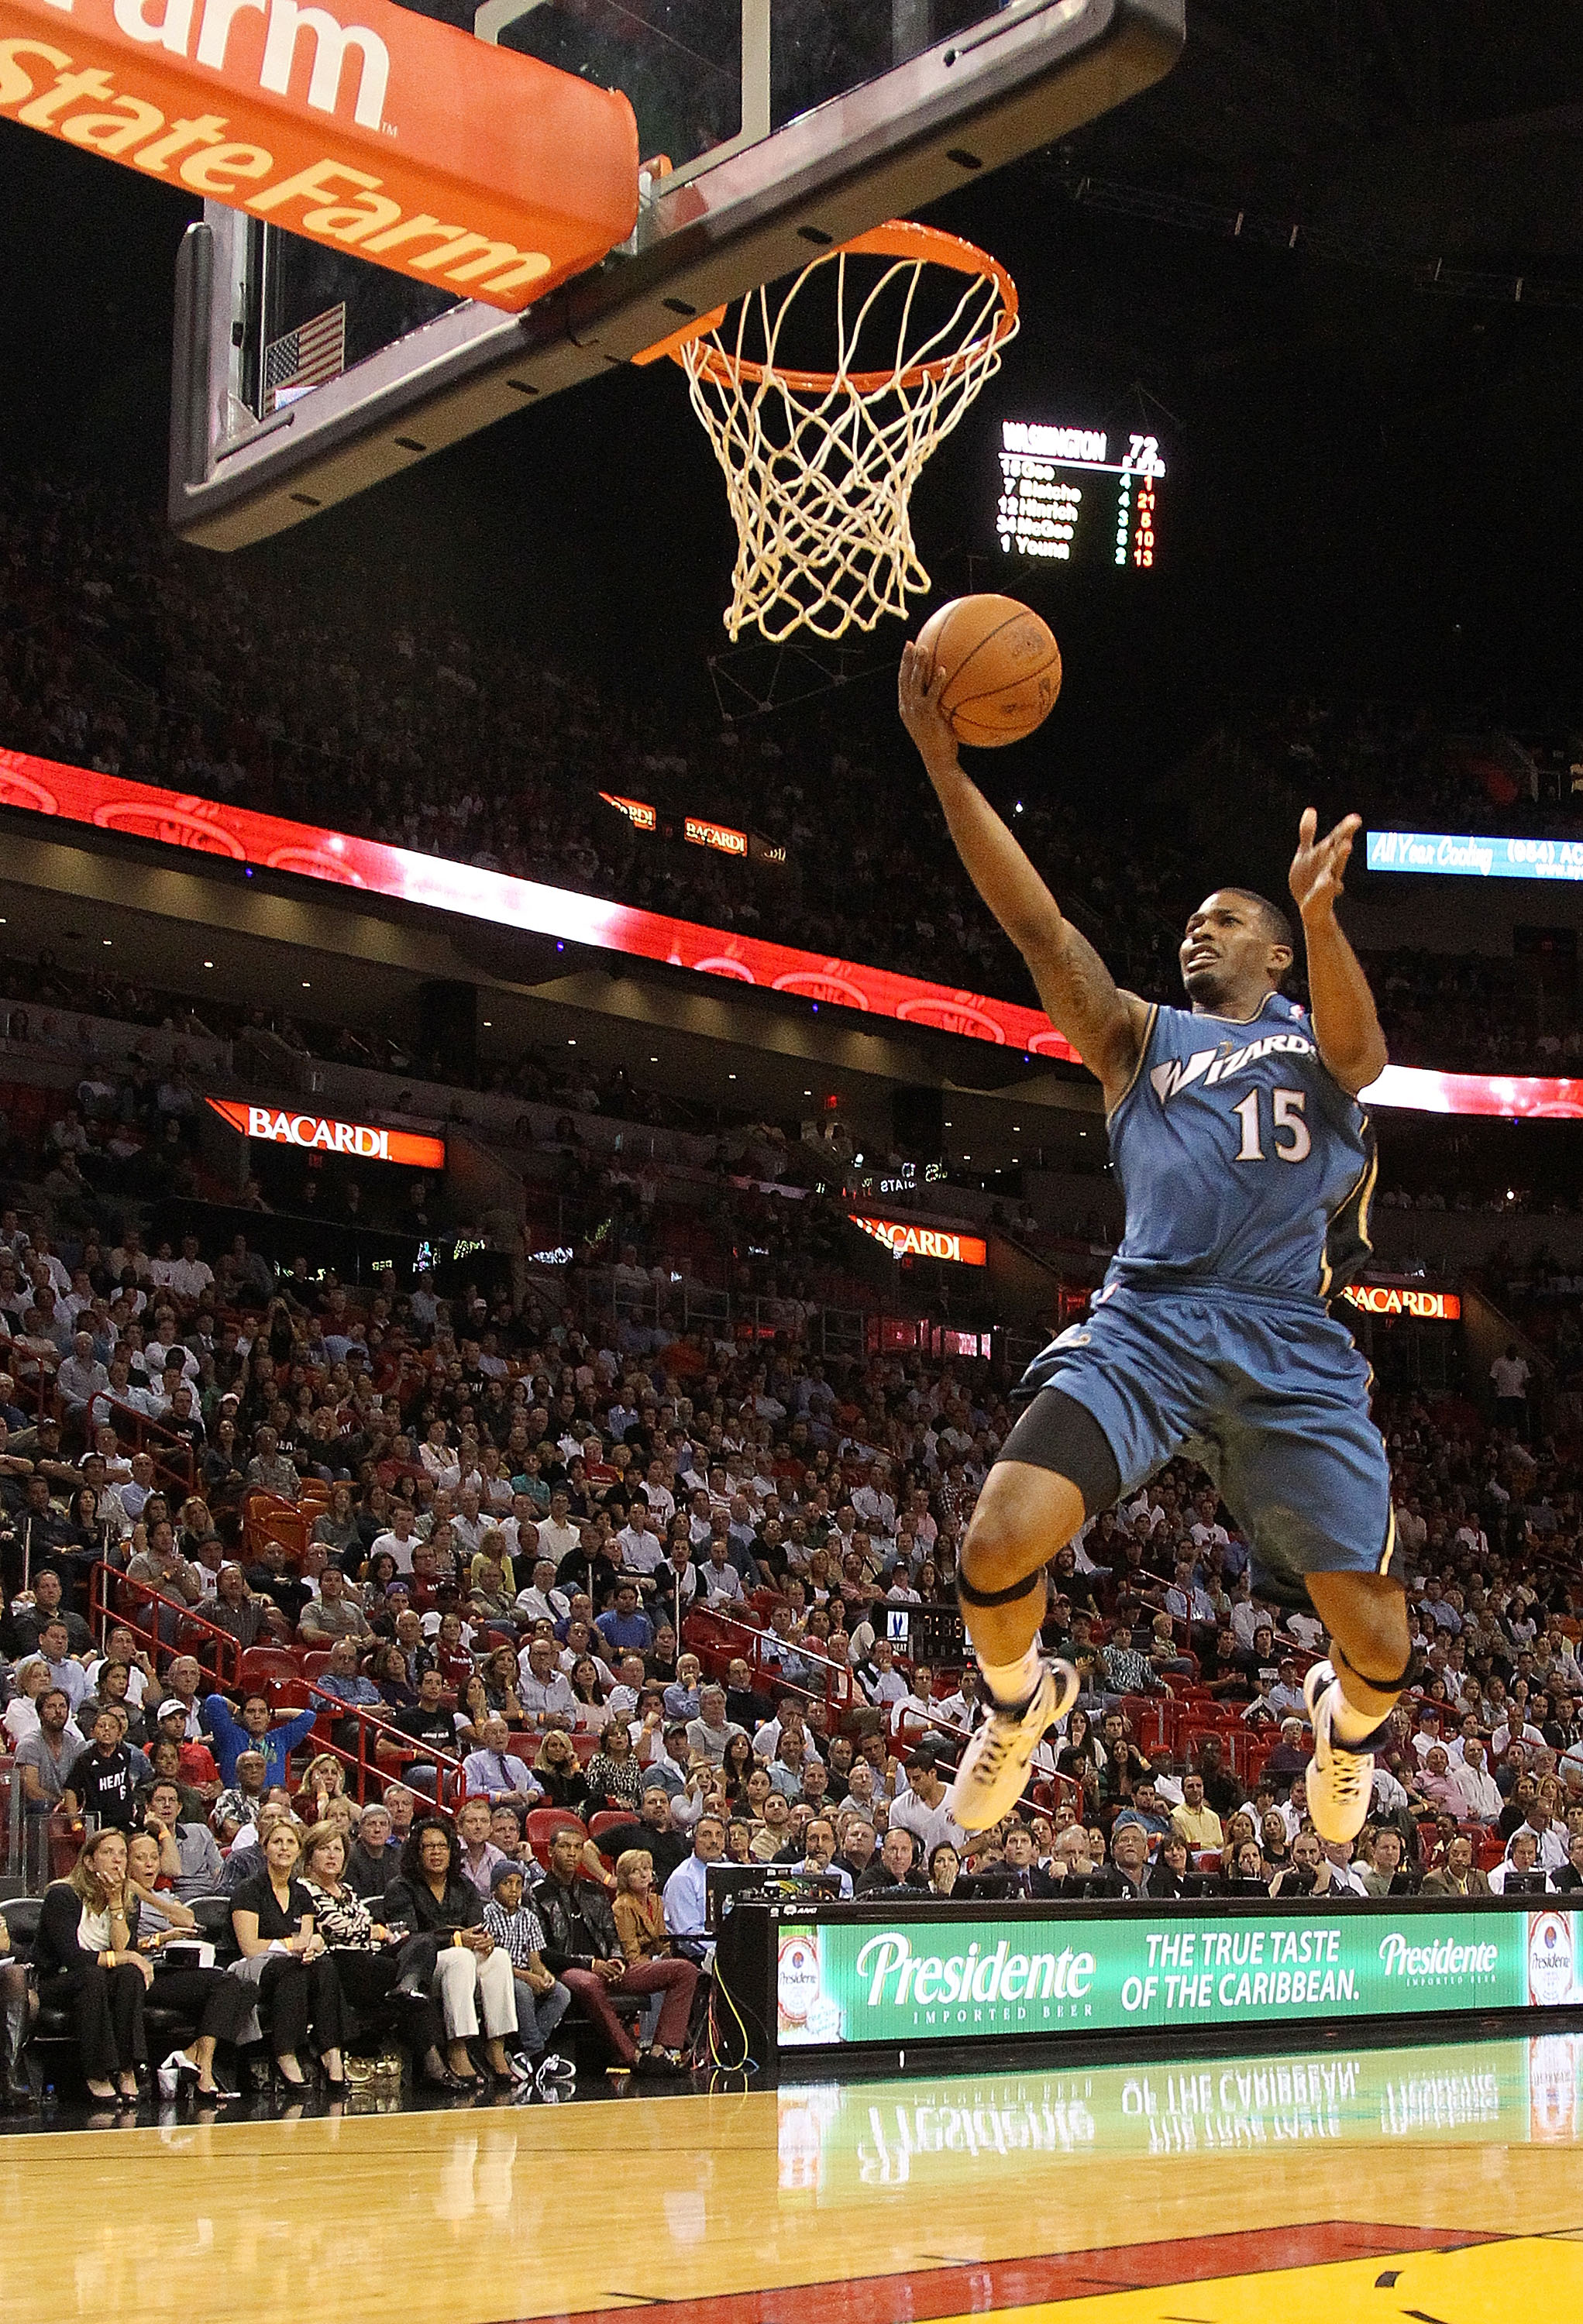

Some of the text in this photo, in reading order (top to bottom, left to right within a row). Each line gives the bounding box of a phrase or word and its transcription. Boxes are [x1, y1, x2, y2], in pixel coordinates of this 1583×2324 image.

[43, 0, 390, 132] arm
[0, 37, 552, 293] State Farm
[1129, 434, 1159, 459] 72
[1003, 477, 1016, 495] 7
[1118, 491, 1130, 508] 4
[1137, 490, 1155, 511] 21
[1120, 473, 1132, 490] 4
[1144, 475, 1152, 491] 1
[1118, 509, 1128, 527] 3
[1000, 533, 1153, 567] 1 Young 2 13
[1135, 528, 1154, 548] 10
[687, 822, 745, 852] BACARDI
[1232, 1087, 1312, 1163] 15
[99, 1767, 126, 1792] HEAT
[119, 1785, 127, 1801] 6
[1145, 1930, 1341, 1968] THE TRUE TASTE
[1378, 1933, 1499, 1976] Presidente
[857, 1932, 1096, 2006] Presidente
[1121, 1969, 1361, 2012] OF THE CARIBBEAN.
[913, 2004, 1093, 2025] IMPORTED BEER
